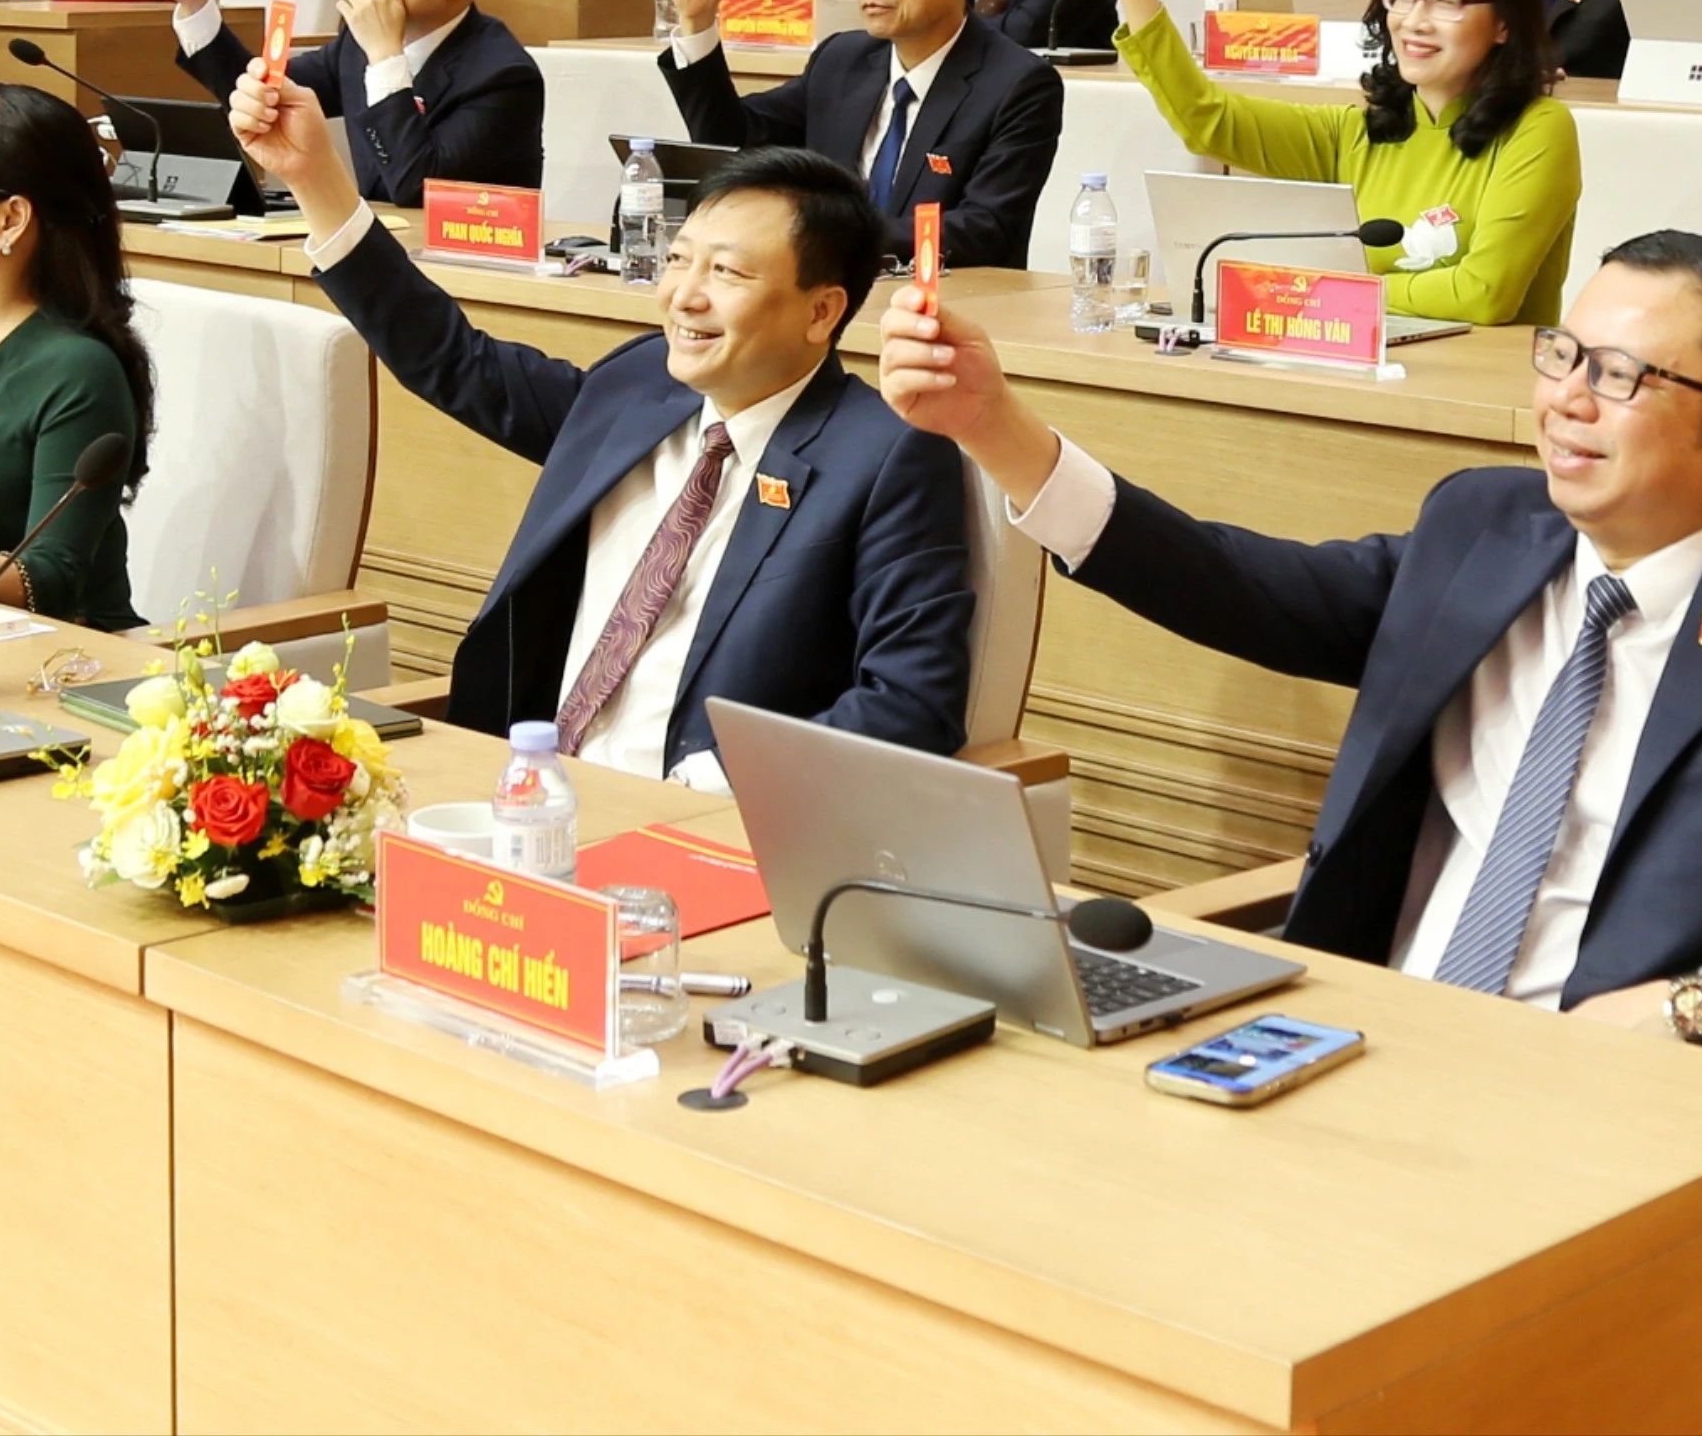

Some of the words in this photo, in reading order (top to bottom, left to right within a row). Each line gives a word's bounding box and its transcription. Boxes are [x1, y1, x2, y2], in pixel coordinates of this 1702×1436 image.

[441, 220, 468, 242] PHAN
[468, 219, 493, 244] QUỐC
[493, 225, 525, 248] NGHĨA
[1246, 307, 1262, 334] LÊ
[1263, 313, 1284, 340] THỊ
[1323, 316, 1352, 345] VÂN
[420, 920, 484, 981] HOÀNG
[487, 942, 521, 994] CHÍ
